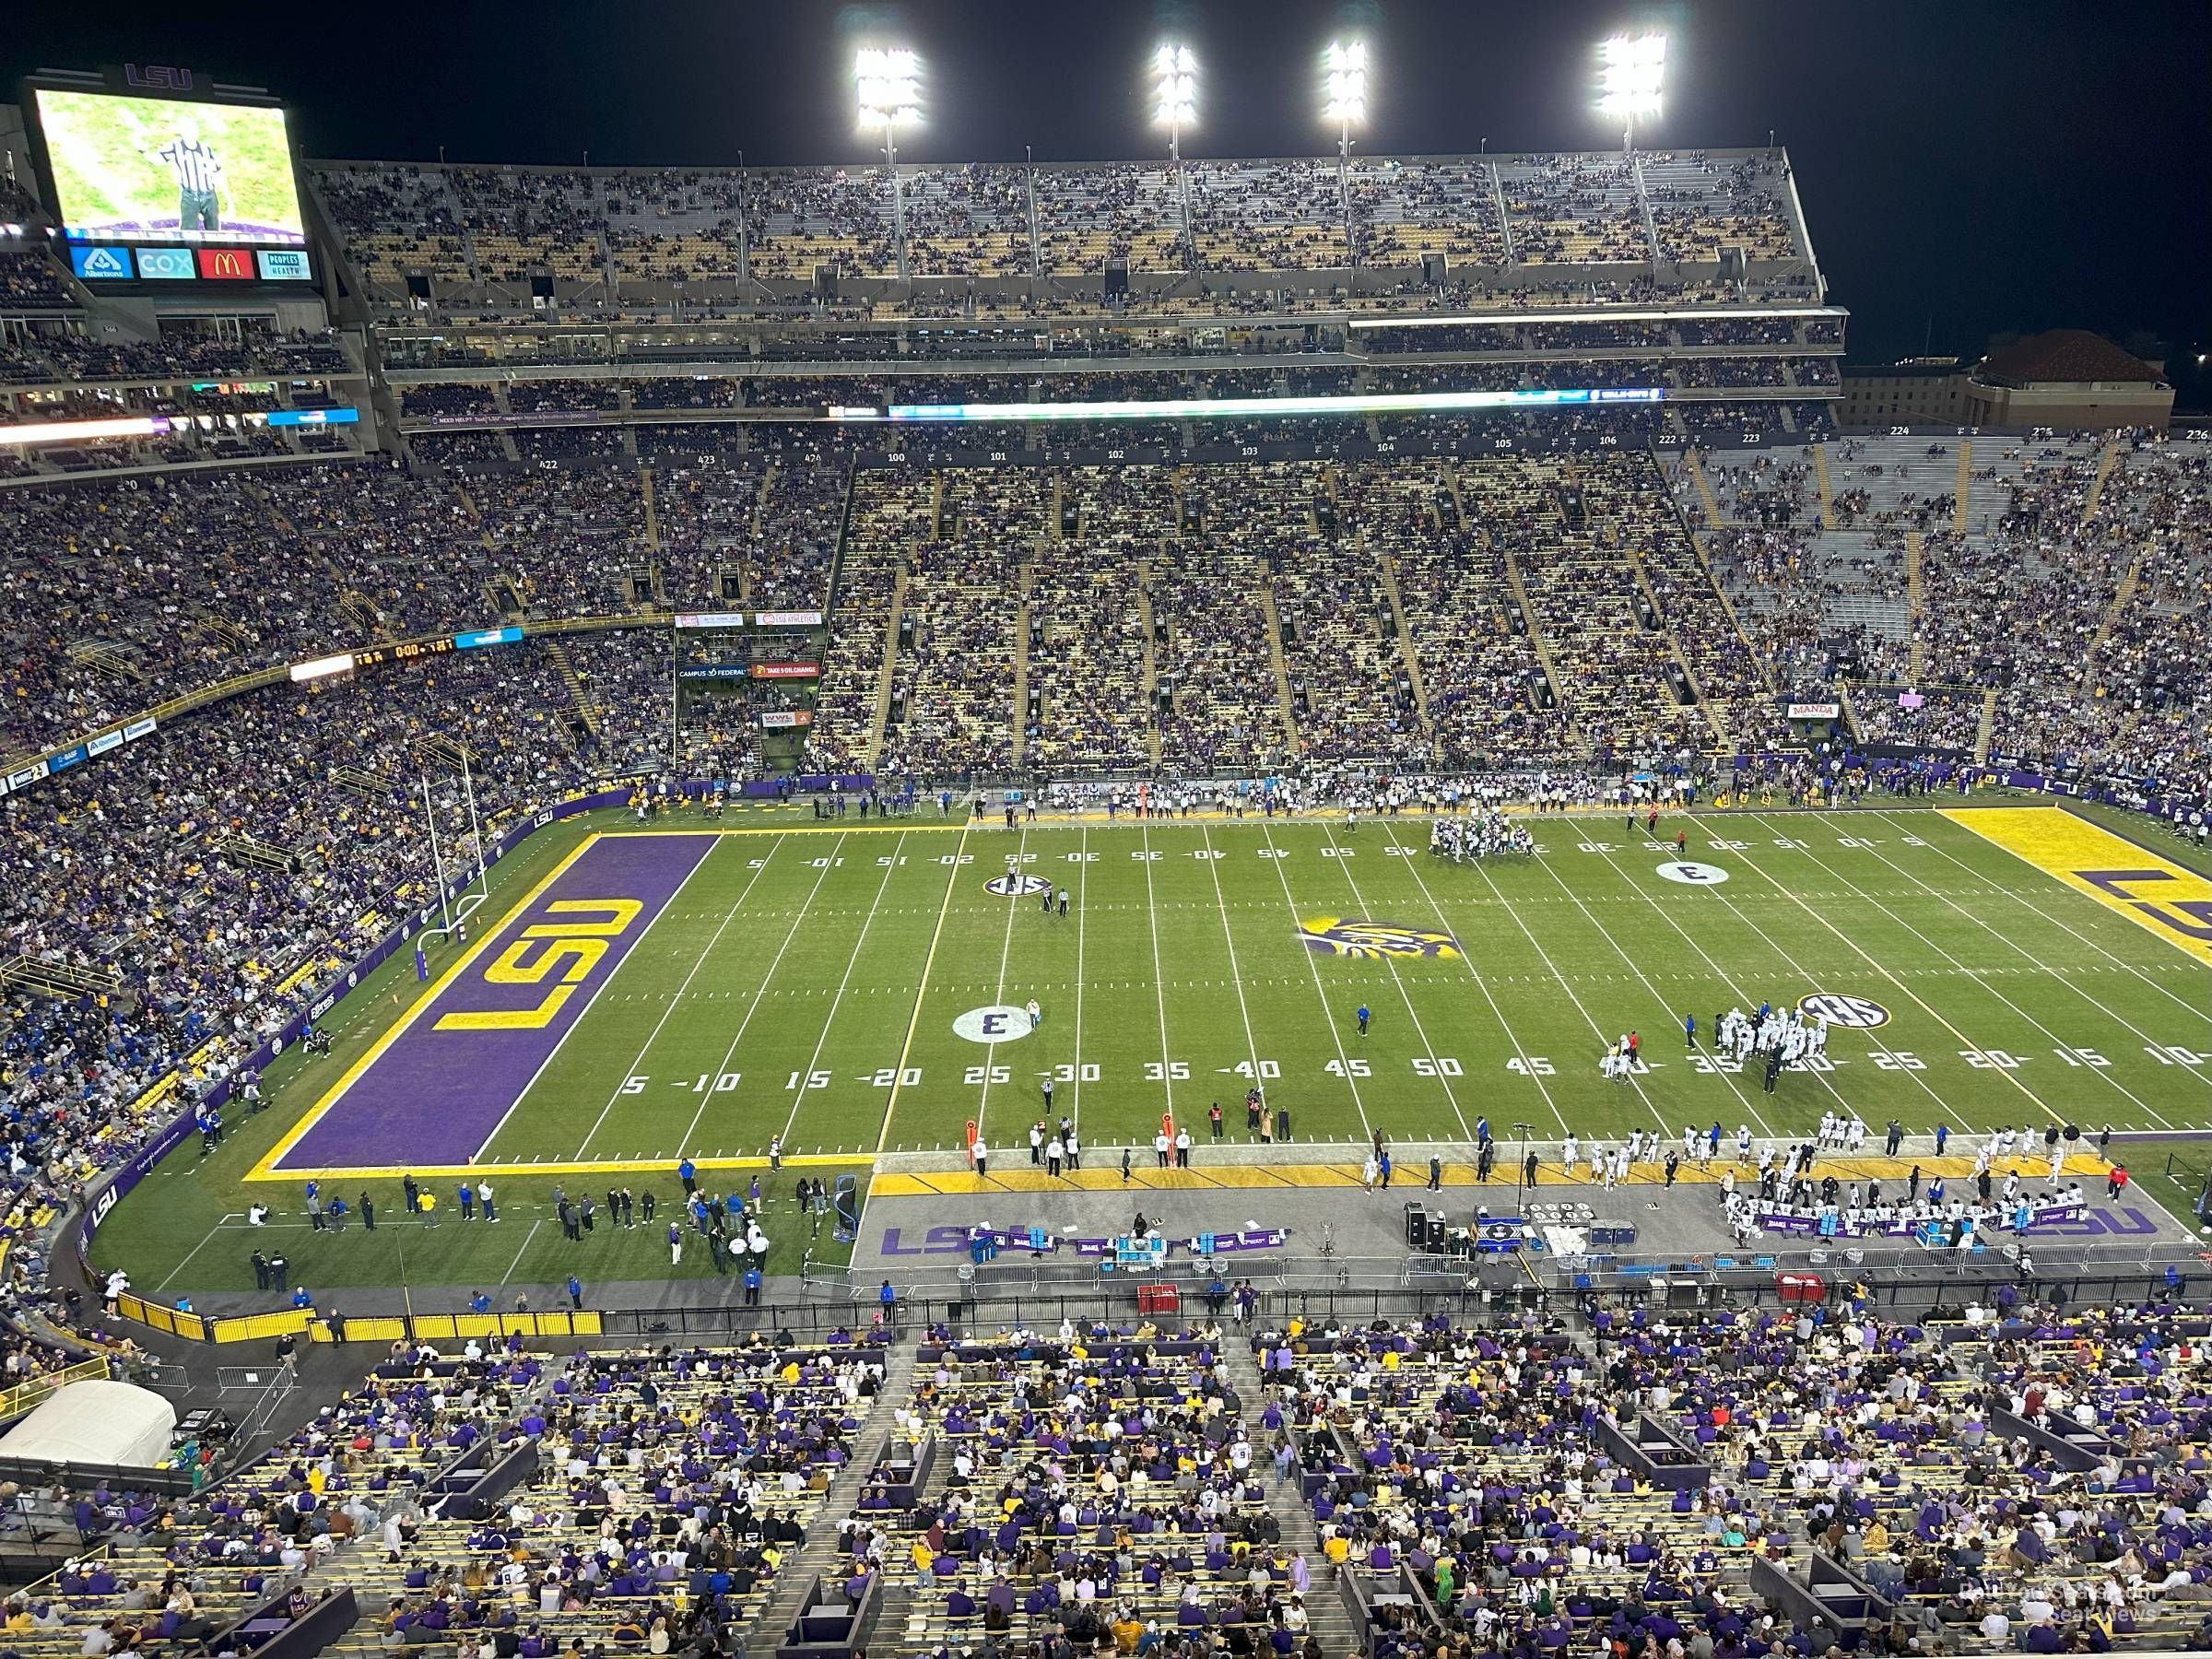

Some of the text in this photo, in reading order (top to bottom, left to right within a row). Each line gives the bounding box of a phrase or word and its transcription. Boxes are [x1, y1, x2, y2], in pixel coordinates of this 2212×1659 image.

[124, 64, 193, 90] LSU
[139, 254, 193, 273] COX
[269, 255, 298, 265] PEOPLES
[272, 266, 300, 276] HEALTH
[1742, 434, 1760, 443] 223
[1889, 427, 1910, 436] 224
[1495, 440, 1512, 448] 105
[1600, 436, 1617, 445] 106
[1659, 435, 1676, 444] 222
[1108, 450, 1124, 459] 102
[1241, 447, 1258, 456] 103
[1377, 443, 1394, 453] 104
[698, 455, 715, 465] 423
[888, 453, 905, 462] 100
[990, 453, 1006, 461] 101
[787, 615, 817, 623] ATHLETICS
[395, 644, 418, 657] 0:00
[1793, 705, 1833, 715] MANDA
[65, 749, 78, 761] BASF
[15, 771, 32, 785] WBRZ
[535, 809, 553, 829] LSU
[432, 899, 643, 1030] LSU
[1867, 1052, 1928, 1070] 25
[1958, 1050, 2020, 1068] 20
[2053, 1048, 2112, 1066] 15
[2143, 1046, 2205, 1065] 10
[1144, 1062, 1191, 1080] 35
[1234, 1060, 1282, 1078] 40
[1324, 1059, 1372, 1077] 45
[1412, 1058, 1464, 1077] 50
[1506, 1057, 1557, 1075] 45
[1686, 1055, 1743, 1073] 35
[785, 1070, 831, 1088] 15
[873, 1068, 922, 1087] 20
[964, 1066, 1011, 1084] 25
[1054, 1064, 1100, 1082] 30
[621, 1076, 650, 1093] 5
[692, 1073, 741, 1092] 10
[92, 1185, 118, 1228] LSU
[1520, 1513, 1526, 1525] 7
[1701, 1561, 1713, 1571] 39
[504, 1573, 512, 1584] 9
[1098, 1577, 1107, 1589] 18
[1482, 1619, 1491, 1633] 7
